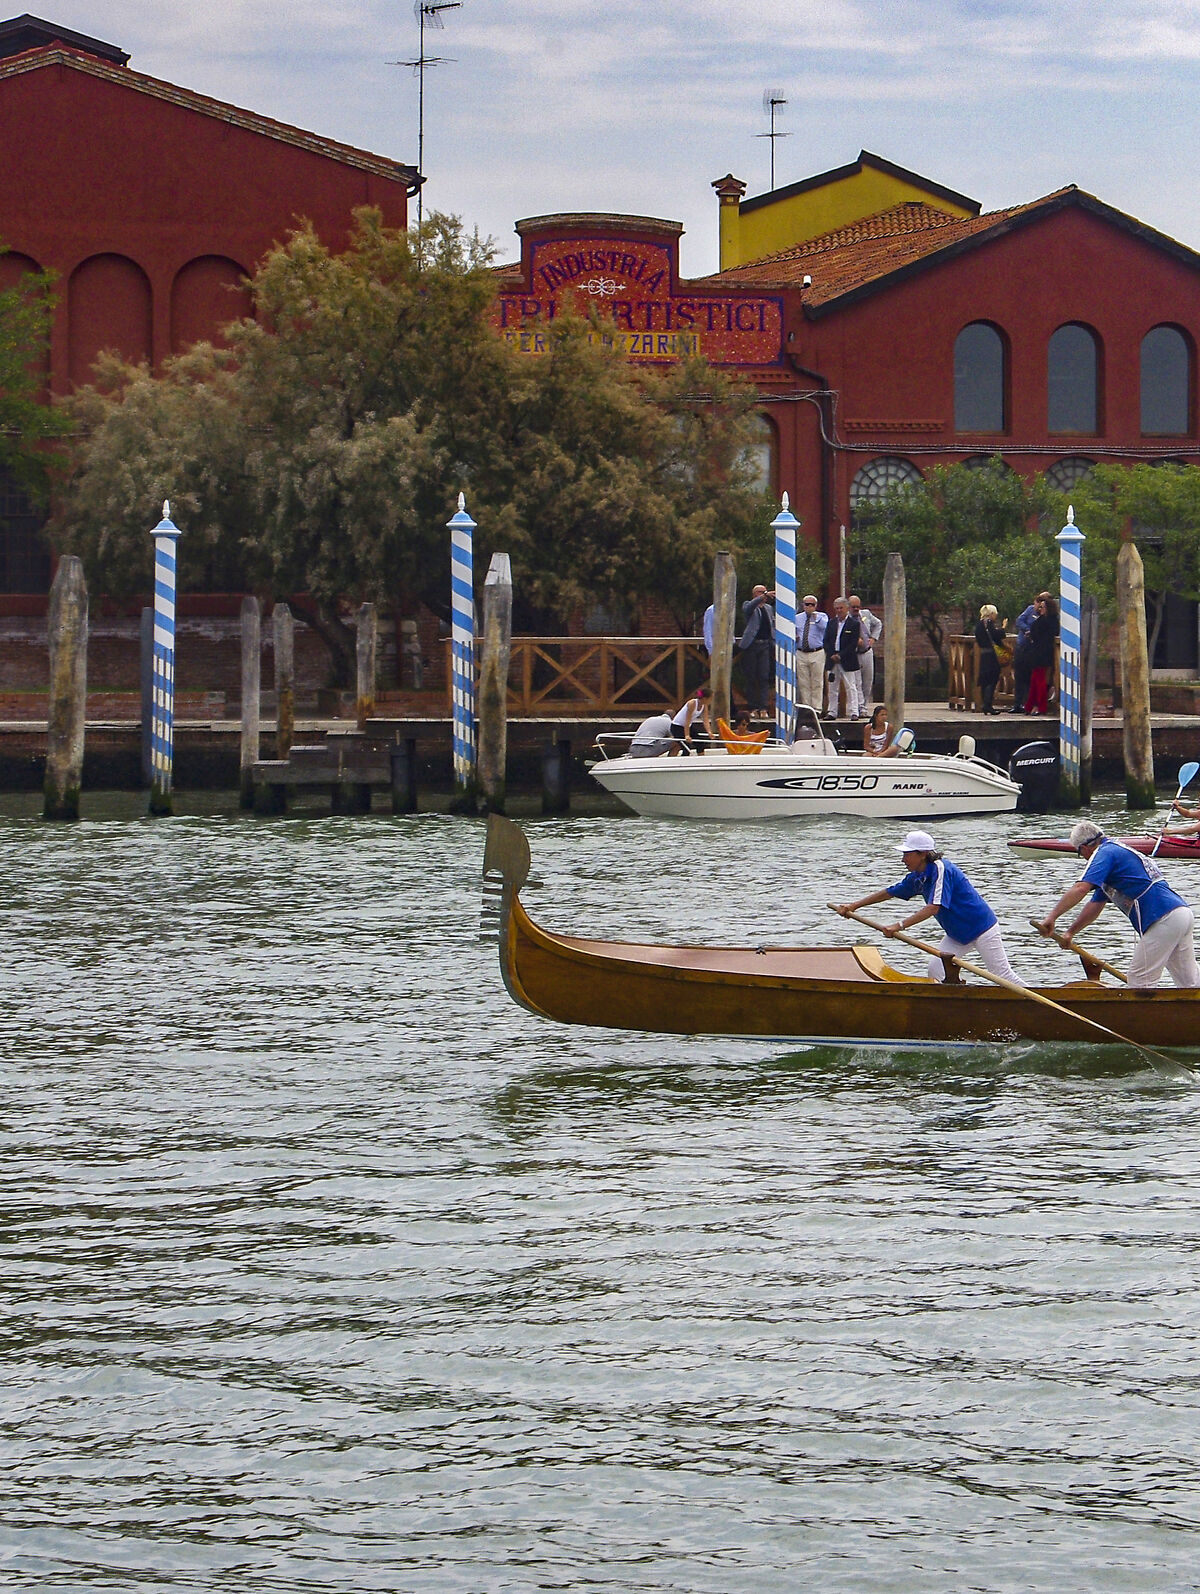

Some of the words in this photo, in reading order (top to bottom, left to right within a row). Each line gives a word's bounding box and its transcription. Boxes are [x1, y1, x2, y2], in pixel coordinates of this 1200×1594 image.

[538, 250, 665, 293] INDUSTRIA
[586, 301, 766, 332] RTISTICI
[1015, 757, 1056, 767] MERCURY
[816, 774, 879, 791] 18.50
